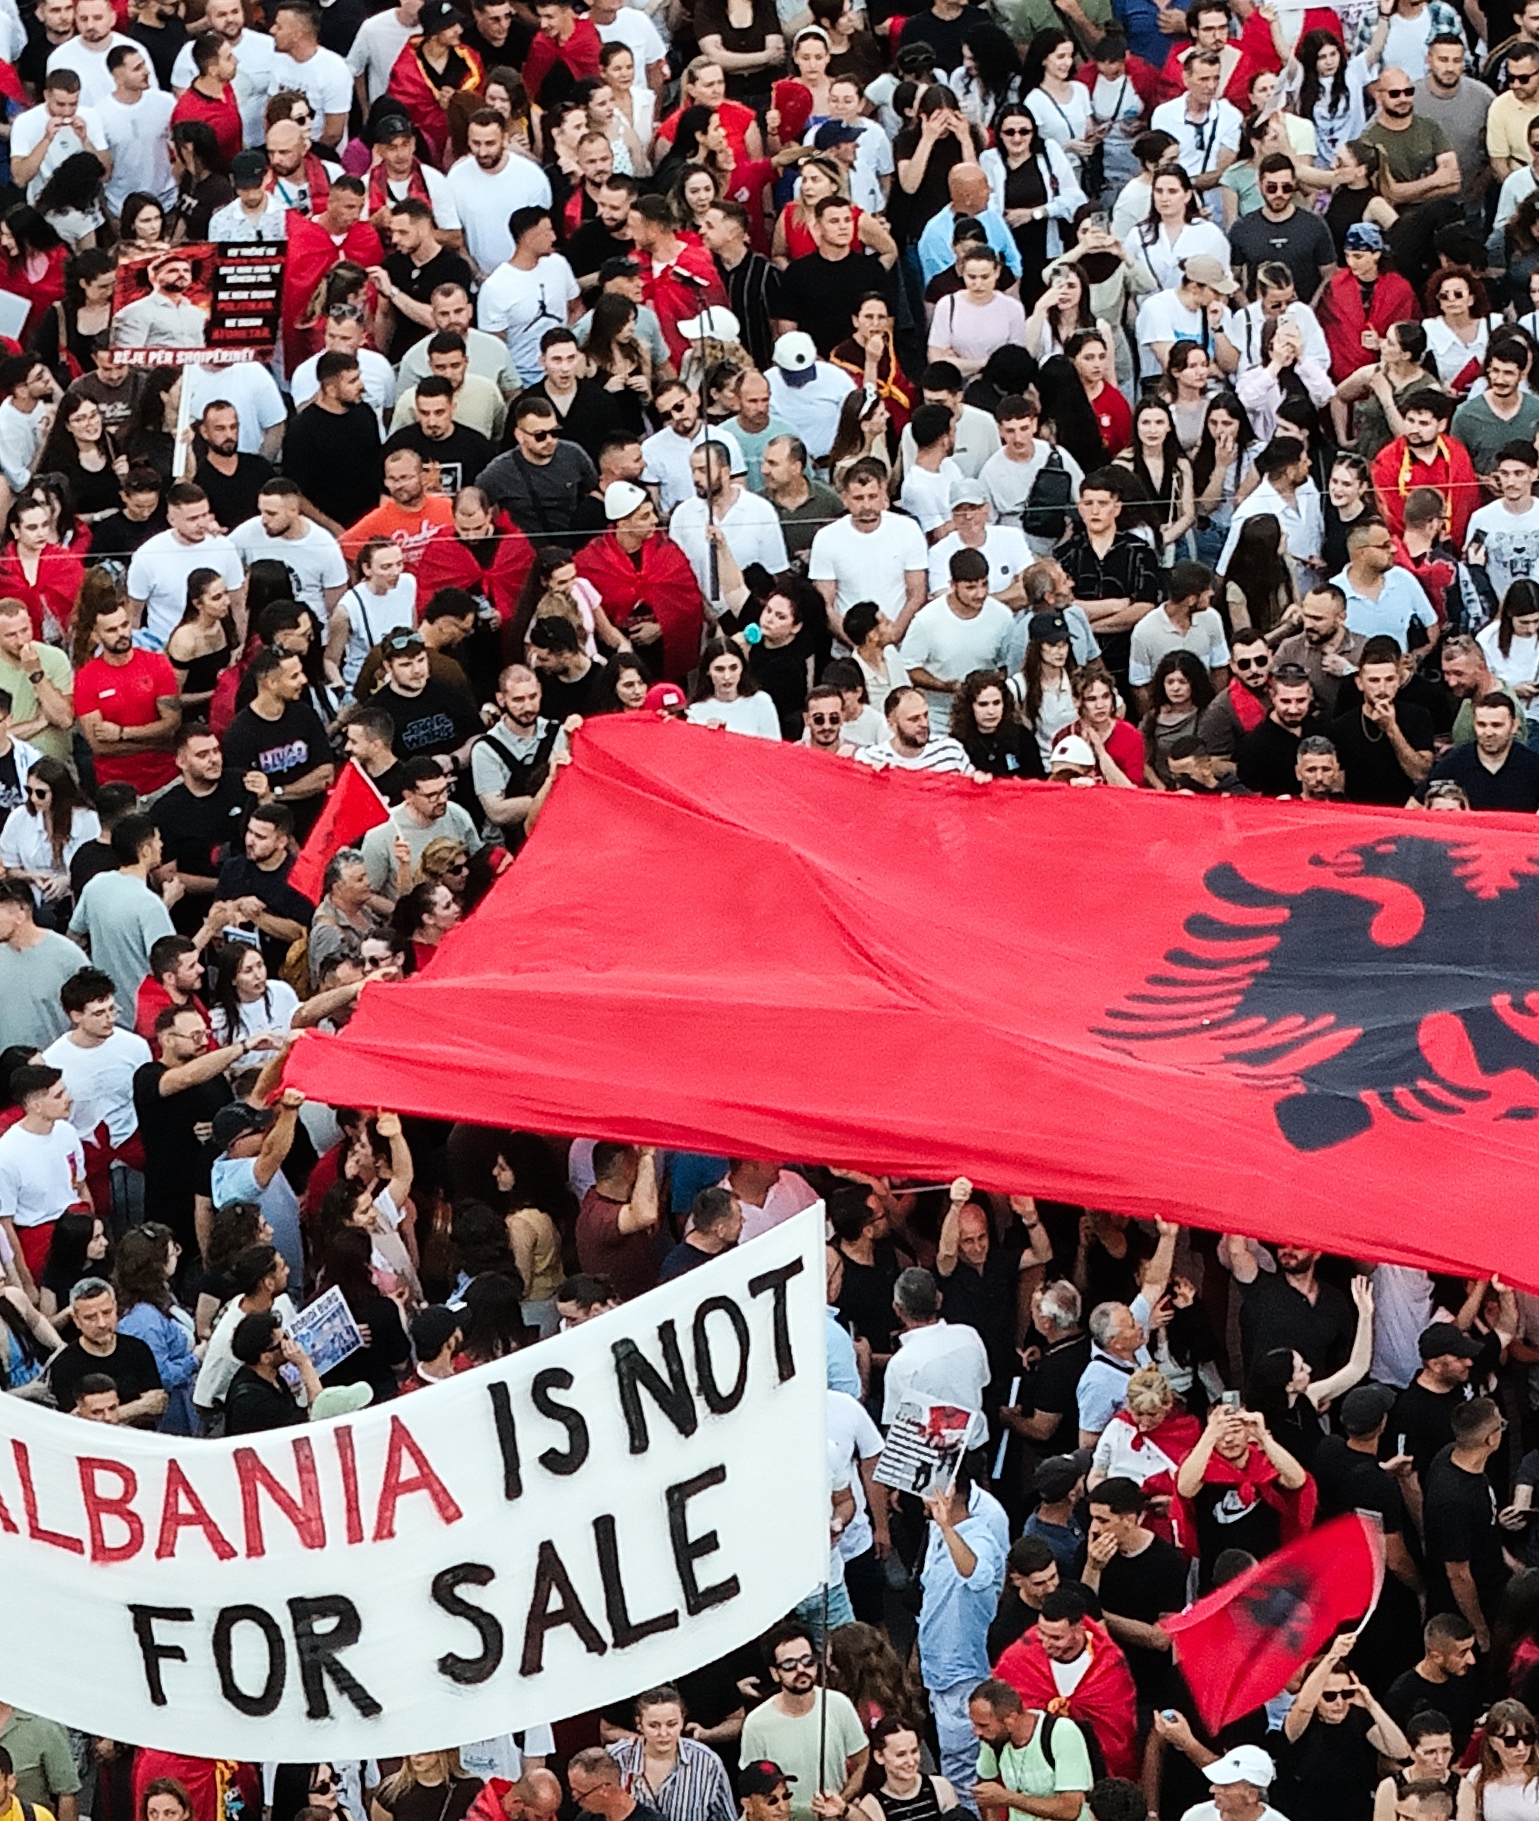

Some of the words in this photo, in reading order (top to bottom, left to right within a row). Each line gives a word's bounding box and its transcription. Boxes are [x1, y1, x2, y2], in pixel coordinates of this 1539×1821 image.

[487, 1366, 591, 1502] IS
[611, 1257, 805, 1456] NOT
[127, 1594, 384, 1721] FOR
[430, 1463, 742, 1685] SALE
